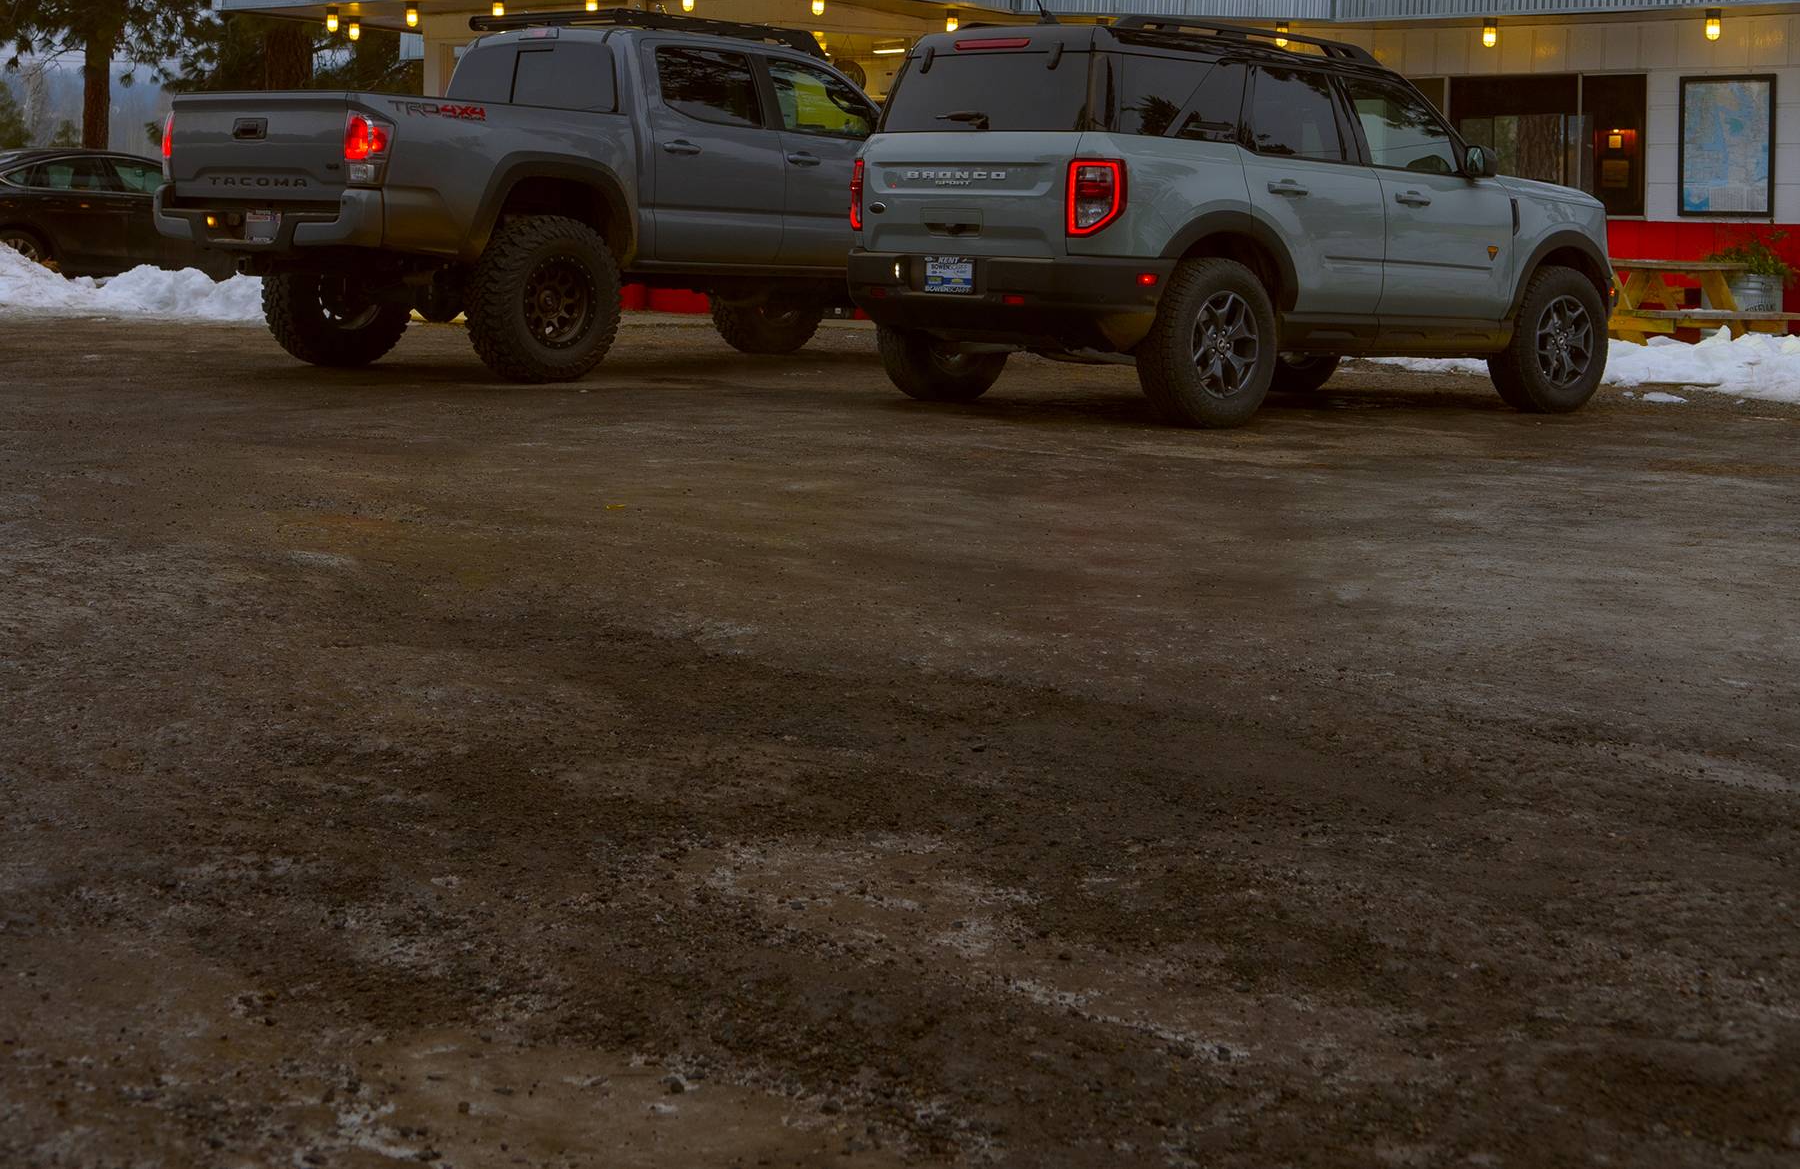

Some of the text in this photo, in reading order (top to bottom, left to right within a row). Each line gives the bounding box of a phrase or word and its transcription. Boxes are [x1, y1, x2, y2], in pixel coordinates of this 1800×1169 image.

[388, 100, 440, 117] TRD
[907, 171, 1007, 179] BRONCO
[208, 176, 308, 187] TACOMA
